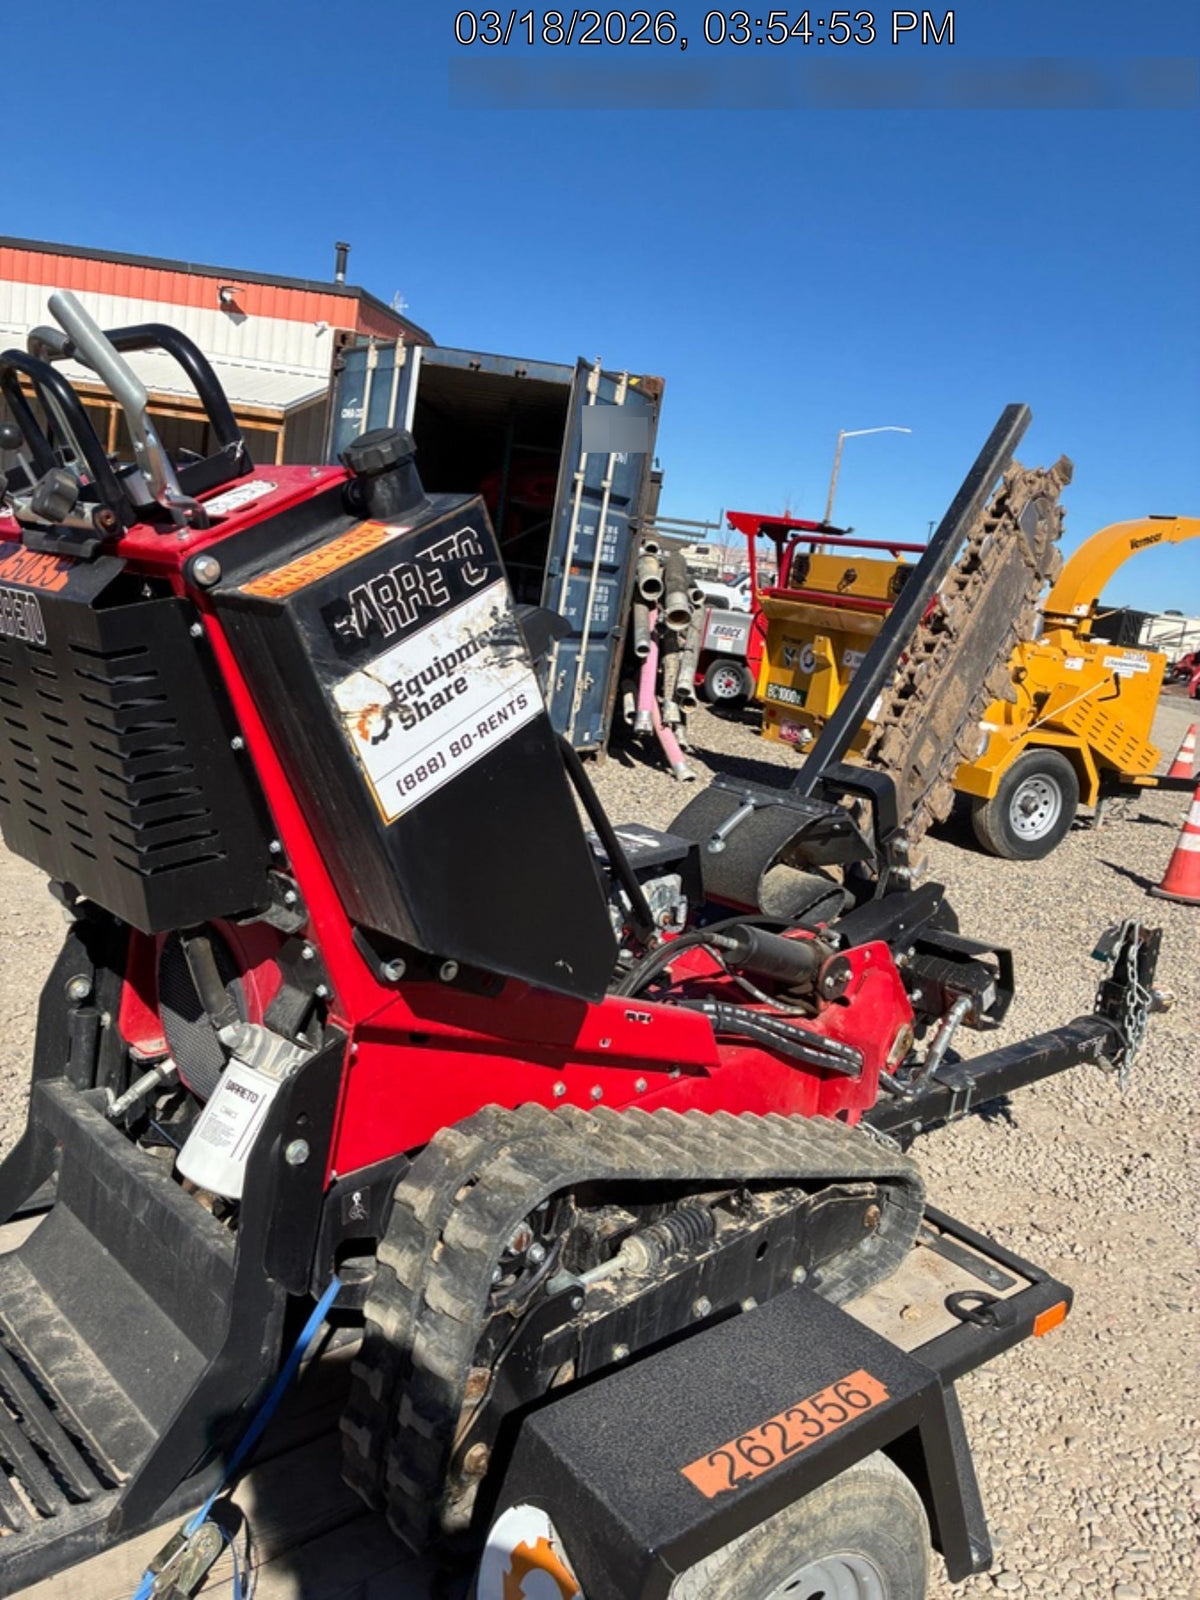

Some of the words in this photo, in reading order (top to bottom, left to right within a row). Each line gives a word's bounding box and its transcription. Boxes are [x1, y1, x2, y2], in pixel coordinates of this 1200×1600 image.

[1129, 533, 1163, 550] Vermeer
[398, 676, 469, 731] Share
[396, 751, 447, 796] (888)
[449, 693, 529, 759] 80-RENTS
[225, 1079, 259, 1104] BARRETO
[707, 1381, 872, 1486] 262356
